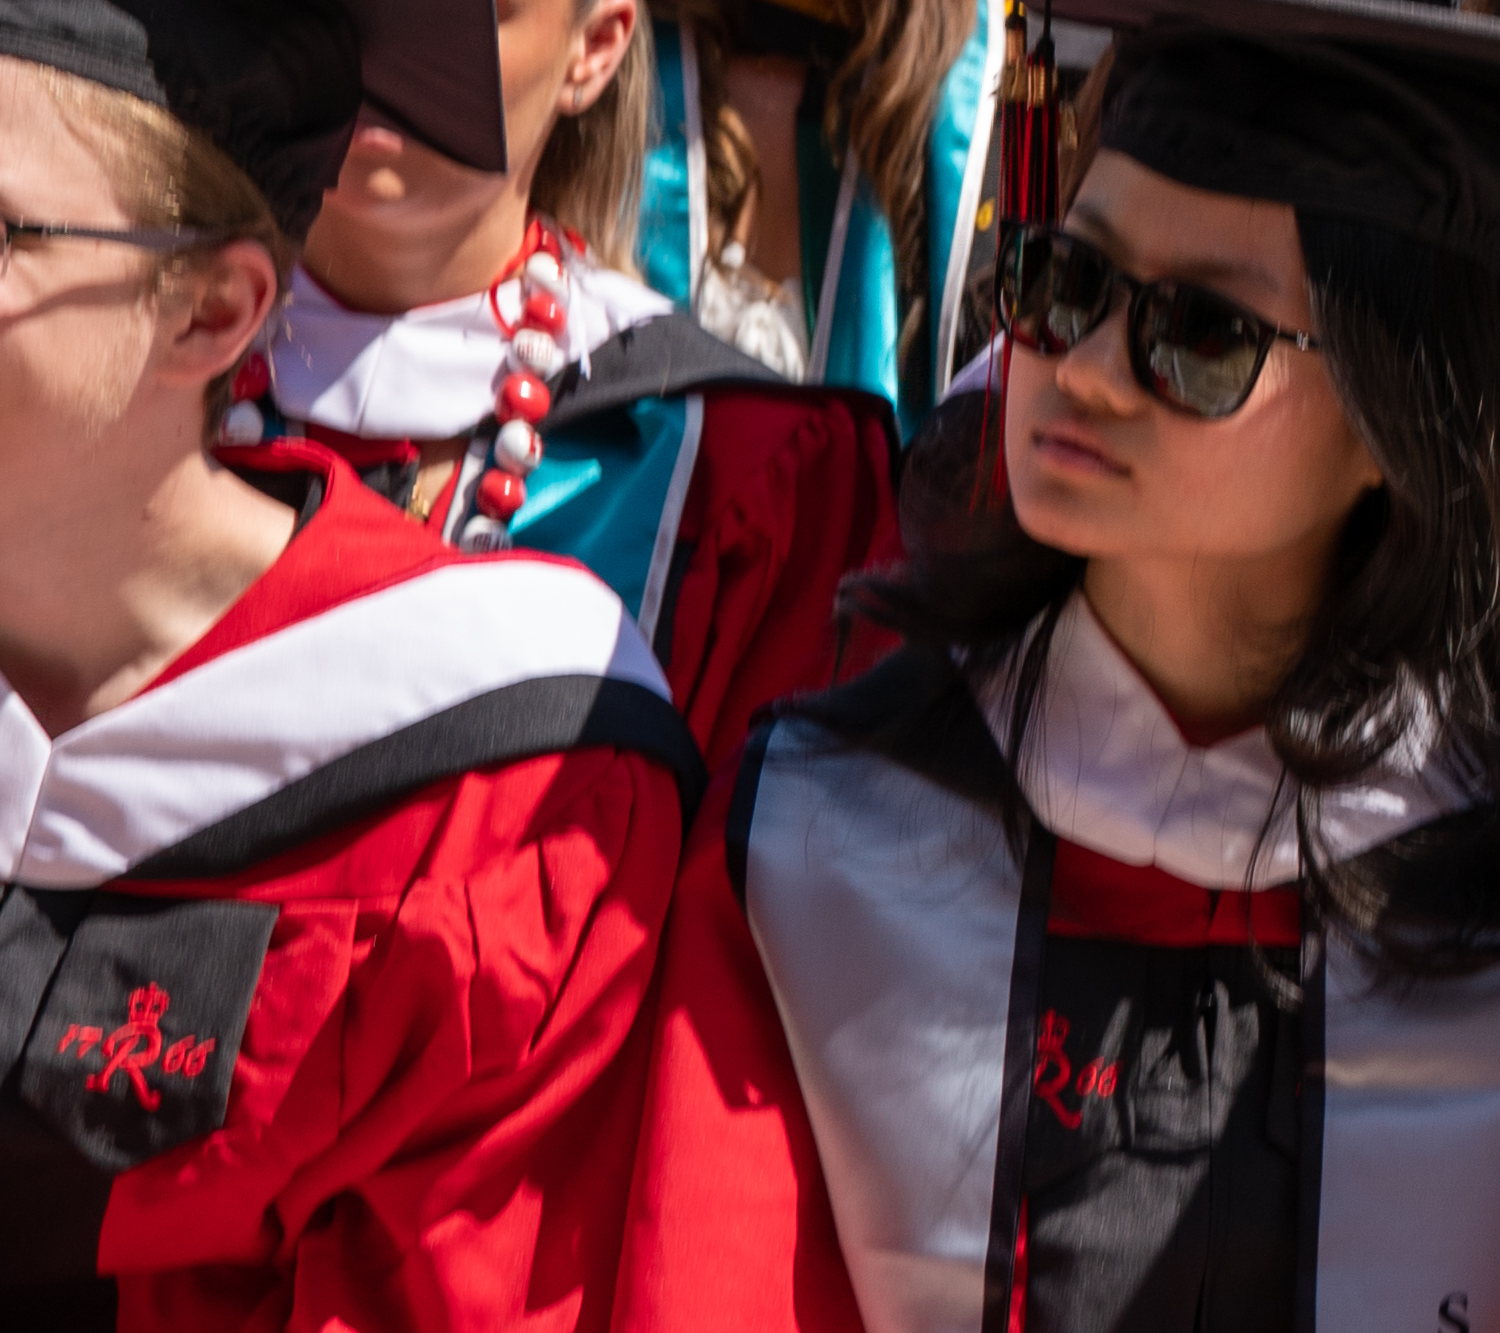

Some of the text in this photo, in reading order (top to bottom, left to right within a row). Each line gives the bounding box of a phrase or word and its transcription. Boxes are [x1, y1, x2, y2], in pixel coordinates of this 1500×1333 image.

[57, 1020, 216, 1112] 17 R 66
[1076, 1055, 1124, 1099] 66
